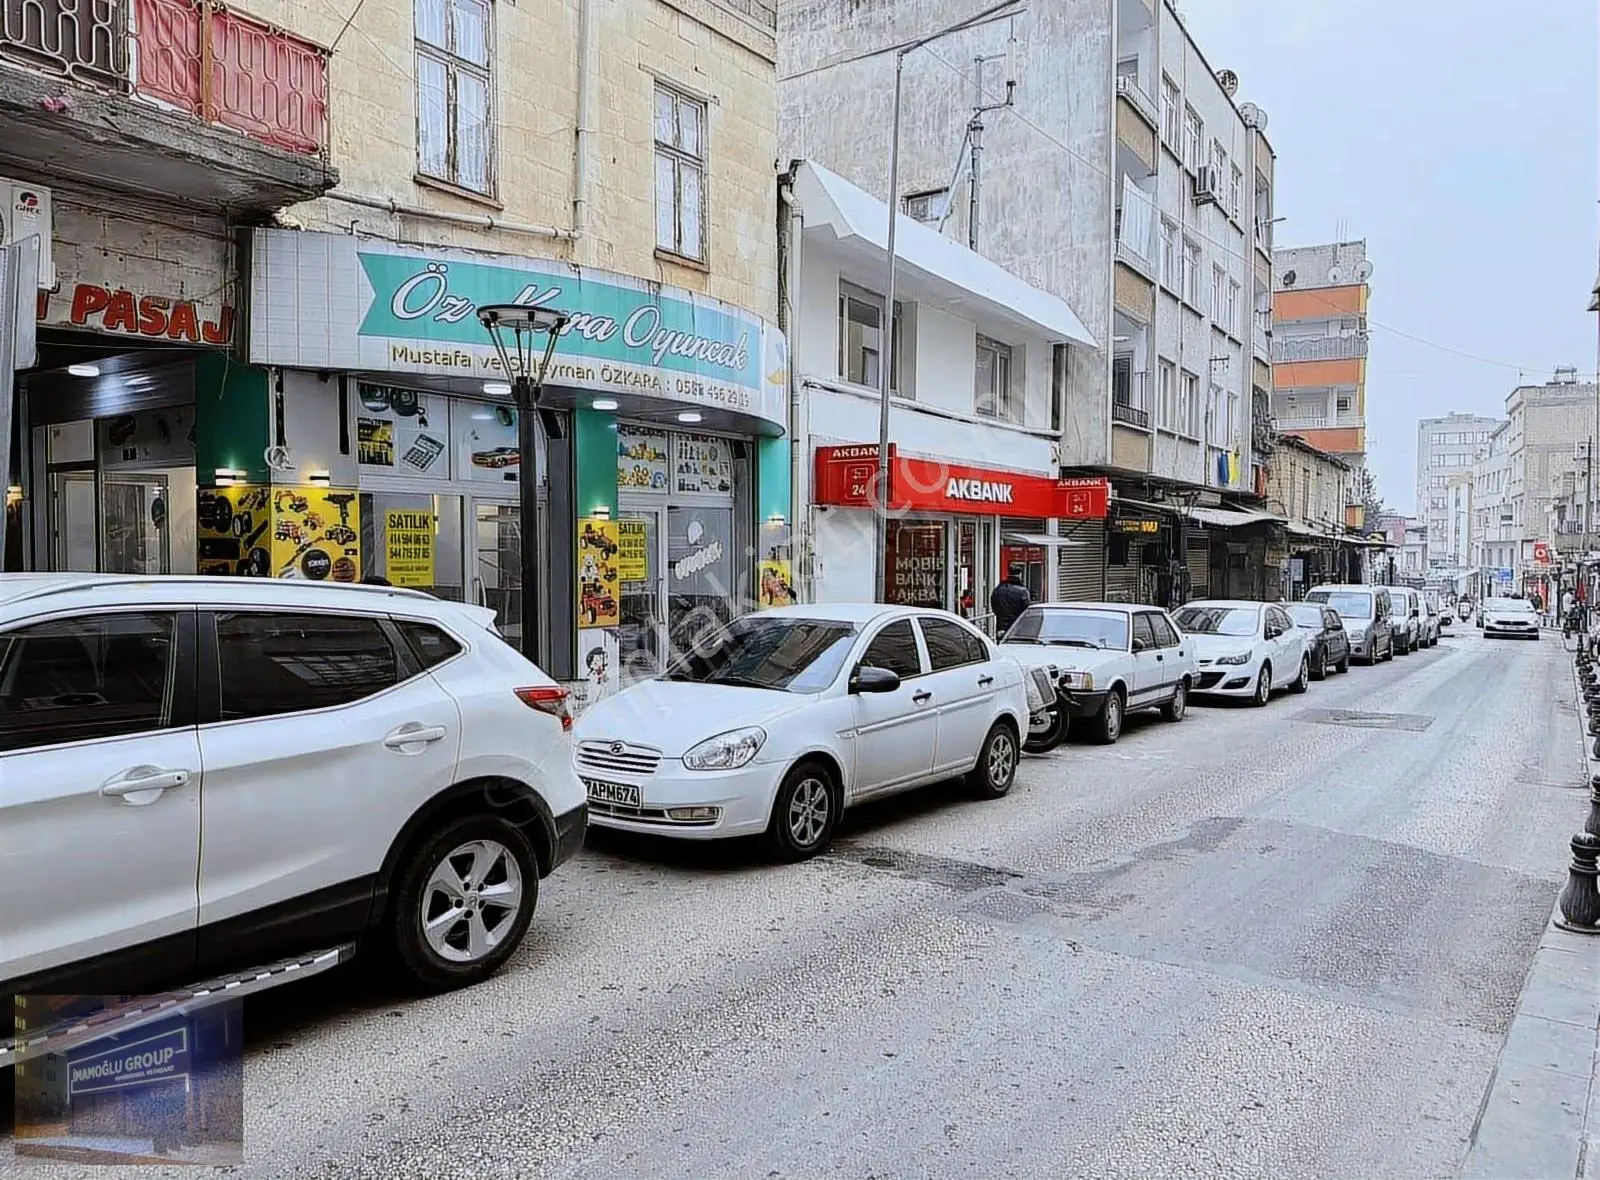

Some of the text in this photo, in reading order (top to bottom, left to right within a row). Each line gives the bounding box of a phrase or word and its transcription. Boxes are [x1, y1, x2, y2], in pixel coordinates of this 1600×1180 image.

[71, 284, 234, 344] PASAJ
[391, 263, 475, 323] Öz
[622, 305, 748, 371] Oyuncak
[392, 345, 471, 368] Mustafa
[481, 356, 500, 369] ve
[600, 364, 662, 390] ÖZKARA
[832, 447, 880, 458] AKBAN
[852, 484, 865, 496] 24
[946, 478, 1013, 503] AKBANK
[1057, 478, 1101, 487] AKBANK
[388, 514, 430, 529] SATILIK
